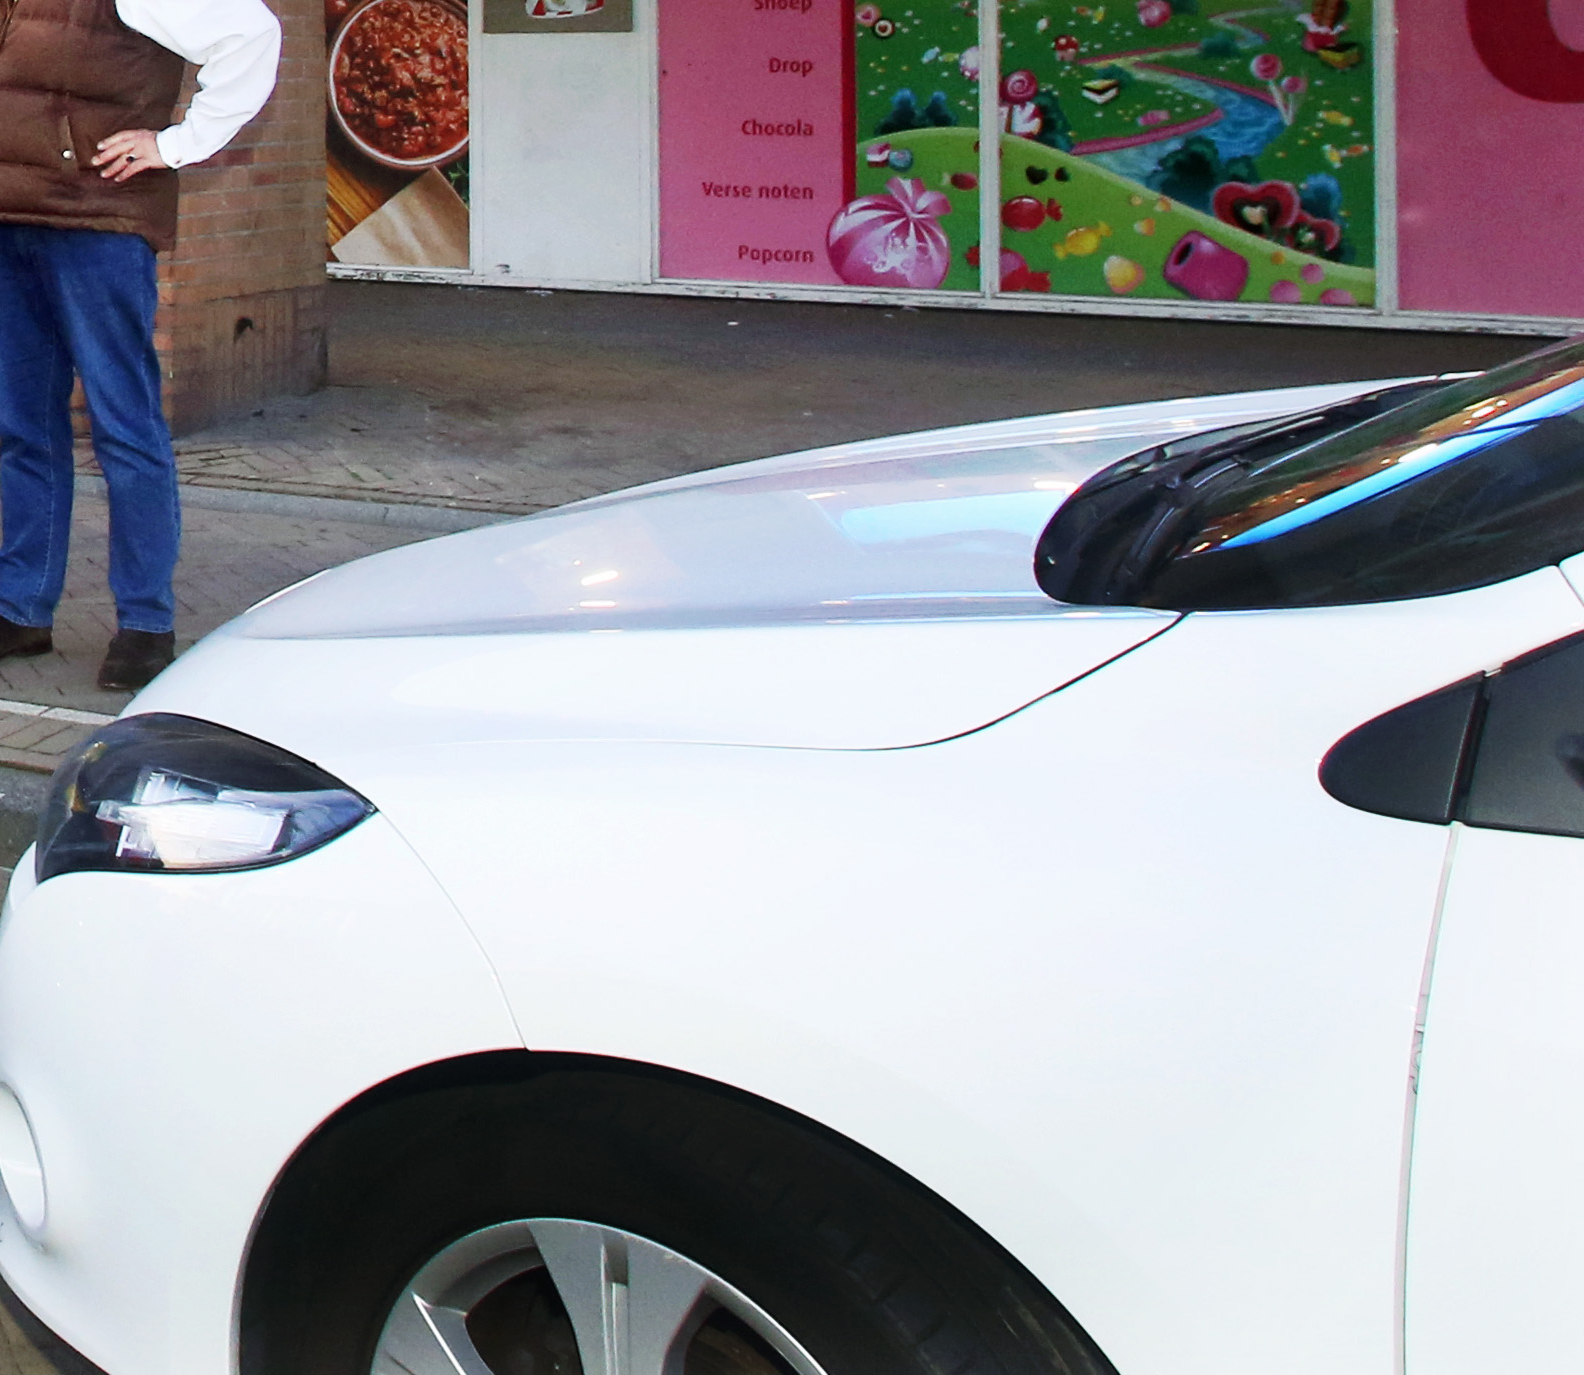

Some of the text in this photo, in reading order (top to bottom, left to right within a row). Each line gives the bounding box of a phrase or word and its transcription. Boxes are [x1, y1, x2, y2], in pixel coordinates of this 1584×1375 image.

[768, 56, 814, 78] Drop
[740, 118, 815, 137] Chocola
[701, 181, 815, 200] Verse noten
[737, 244, 815, 265] Popcorn
